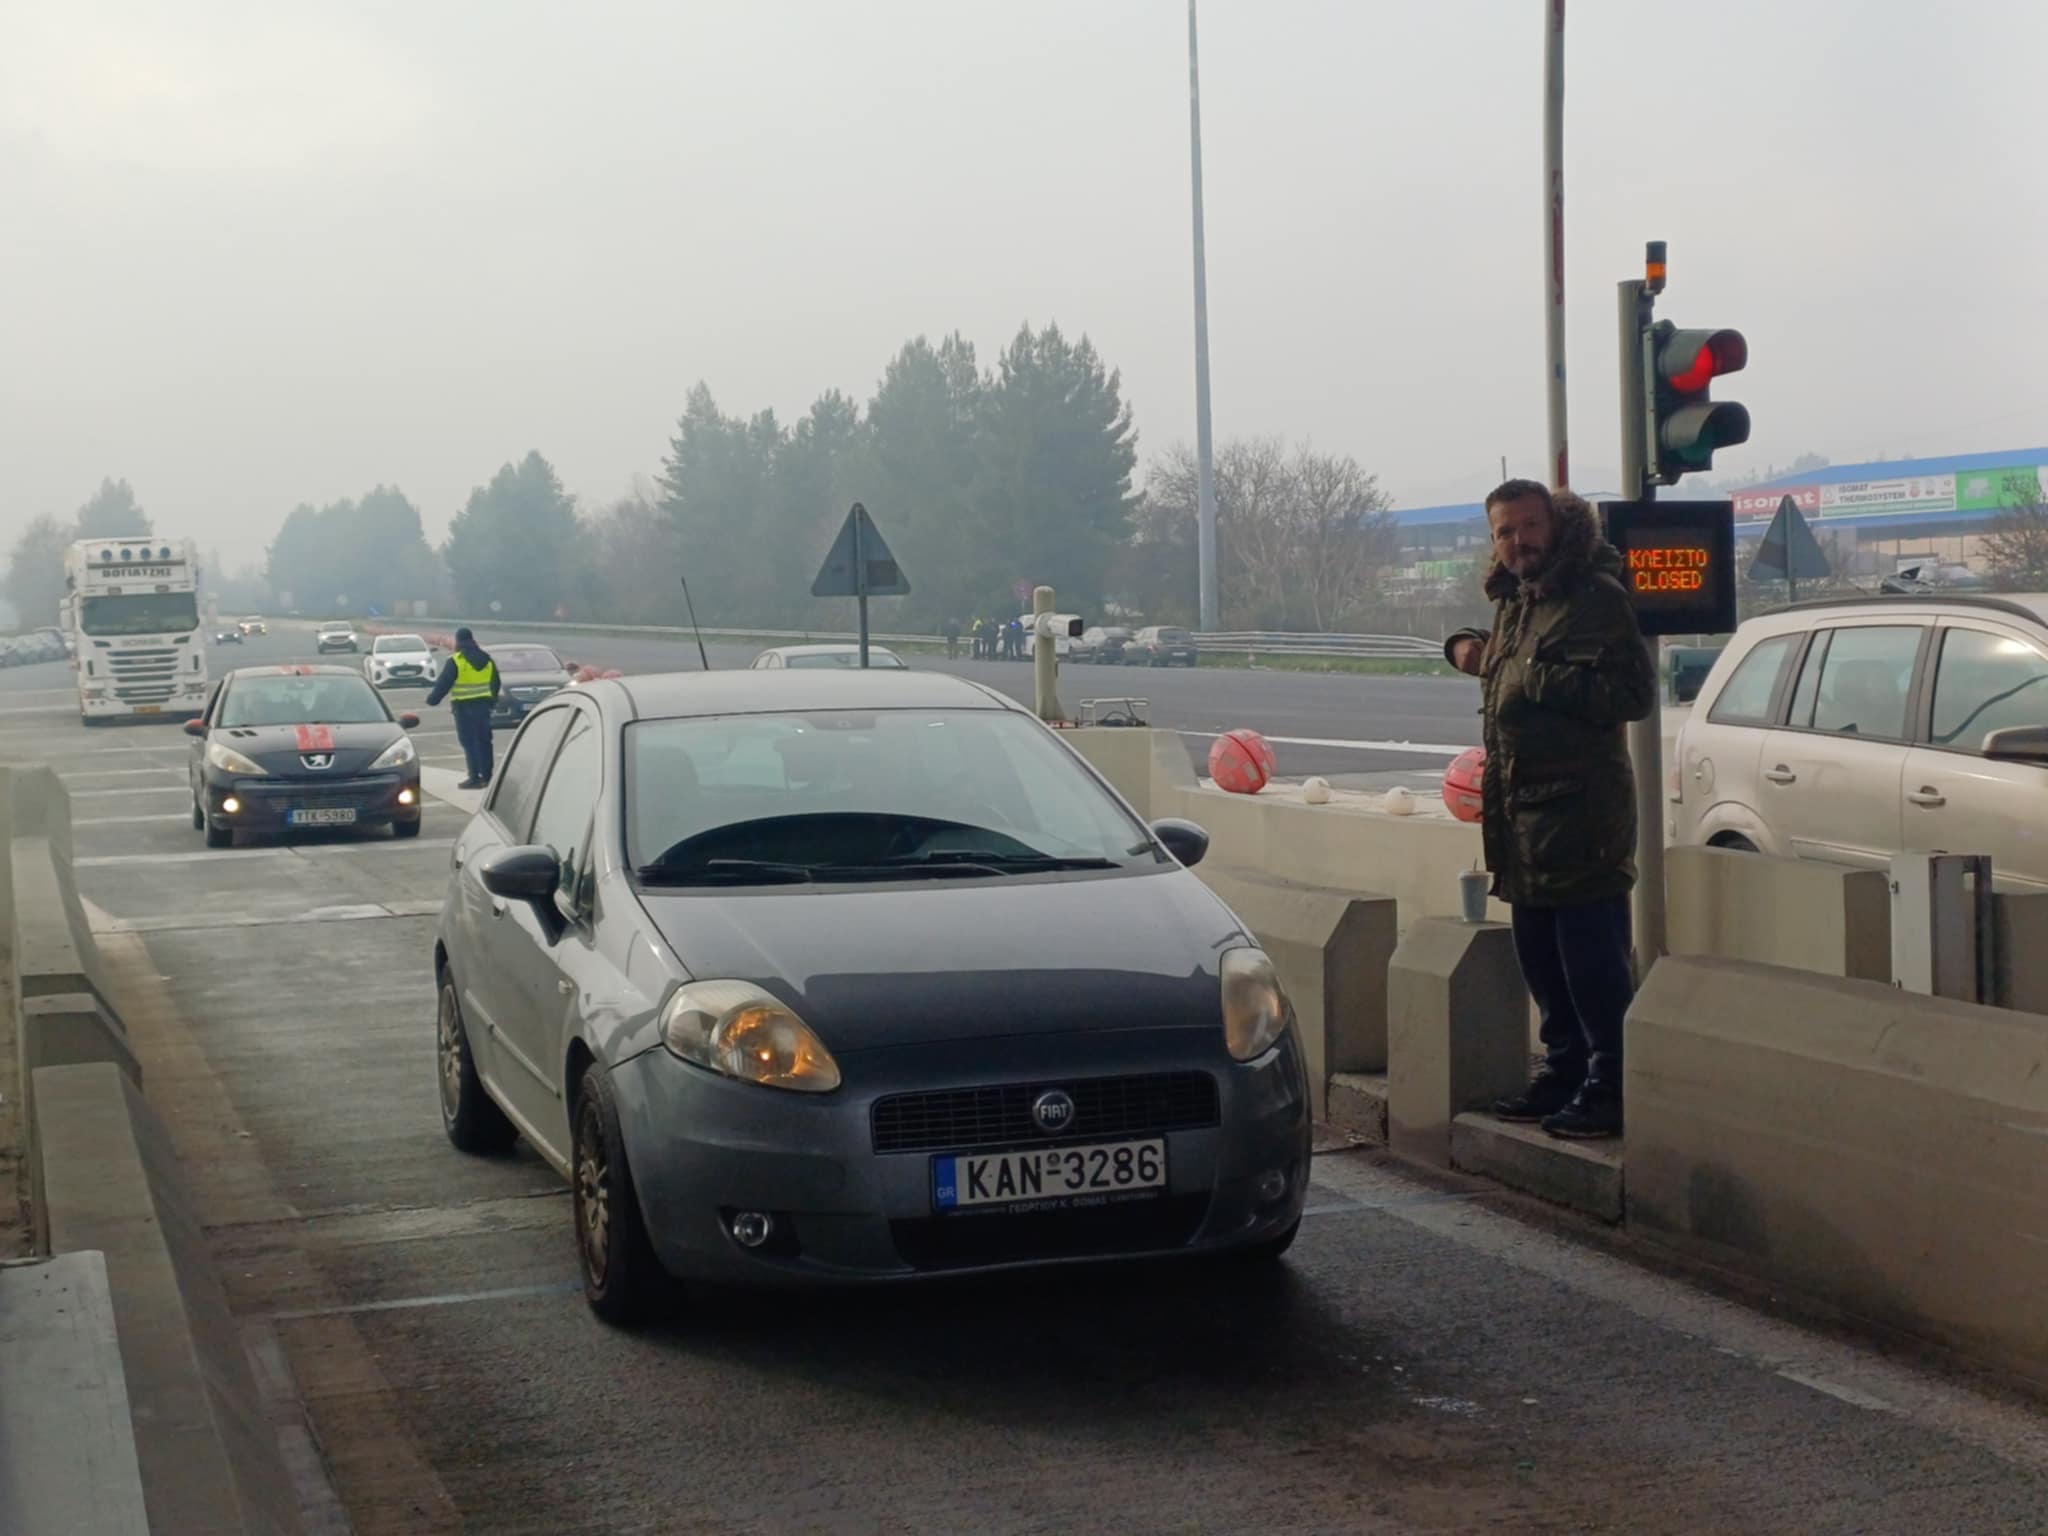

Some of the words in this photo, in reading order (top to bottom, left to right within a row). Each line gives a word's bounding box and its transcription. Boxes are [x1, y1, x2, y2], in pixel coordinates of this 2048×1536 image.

[1629, 549, 1707, 568] ΚΛΕΙΣΤΟ
[1635, 571, 1702, 590] CLOSED
[1040, 1104, 1068, 1121] FIAT
[937, 1186, 955, 1199] GR
